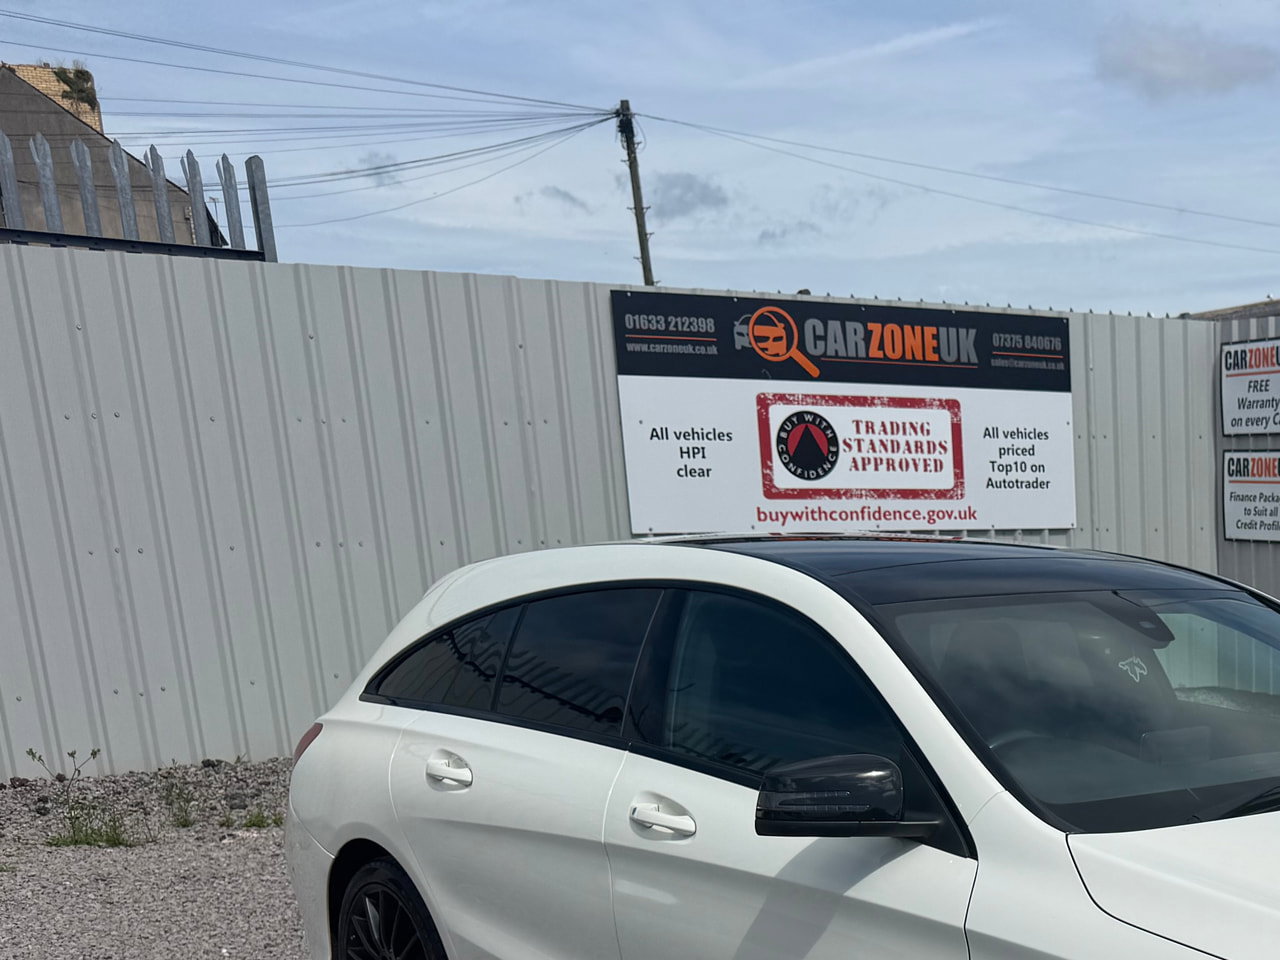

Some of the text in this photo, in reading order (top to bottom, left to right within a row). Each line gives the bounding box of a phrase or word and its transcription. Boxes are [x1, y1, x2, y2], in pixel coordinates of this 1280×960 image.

[624, 313, 716, 333] 01633 212398
[804, 318, 979, 364] CARZONEUK
[992, 332, 1062, 351] 07375 840676
[626, 343, 718, 355] www.carzoneuk.co.uk
[1247, 379, 1271, 393] FREE
[1237, 397, 1280, 412] Warranty
[779, 413, 834, 439] BUY WITH
[851, 419, 932, 436] TRADING
[1231, 417, 1244, 427] on
[1245, 415, 1271, 430] every
[649, 427, 734, 442] All vehicles
[982, 427, 1050, 441] All vehicles
[679, 446, 707, 460] HPI
[842, 437, 949, 456] STANDARDS
[998, 444, 1035, 459] priced
[779, 444, 838, 479] CONFIDENCE
[848, 456, 945, 473] APPROVED
[1030, 464, 1046, 474] on
[676, 464, 712, 478] clear
[985, 477, 1051, 490] Autotrader
[1229, 491, 1257, 503] Finance
[756, 505, 978, 525] buywithconfidence.gov.uk
[1243, 506, 1279, 517] to Suit all
[1236, 519, 1257, 531] Credit
